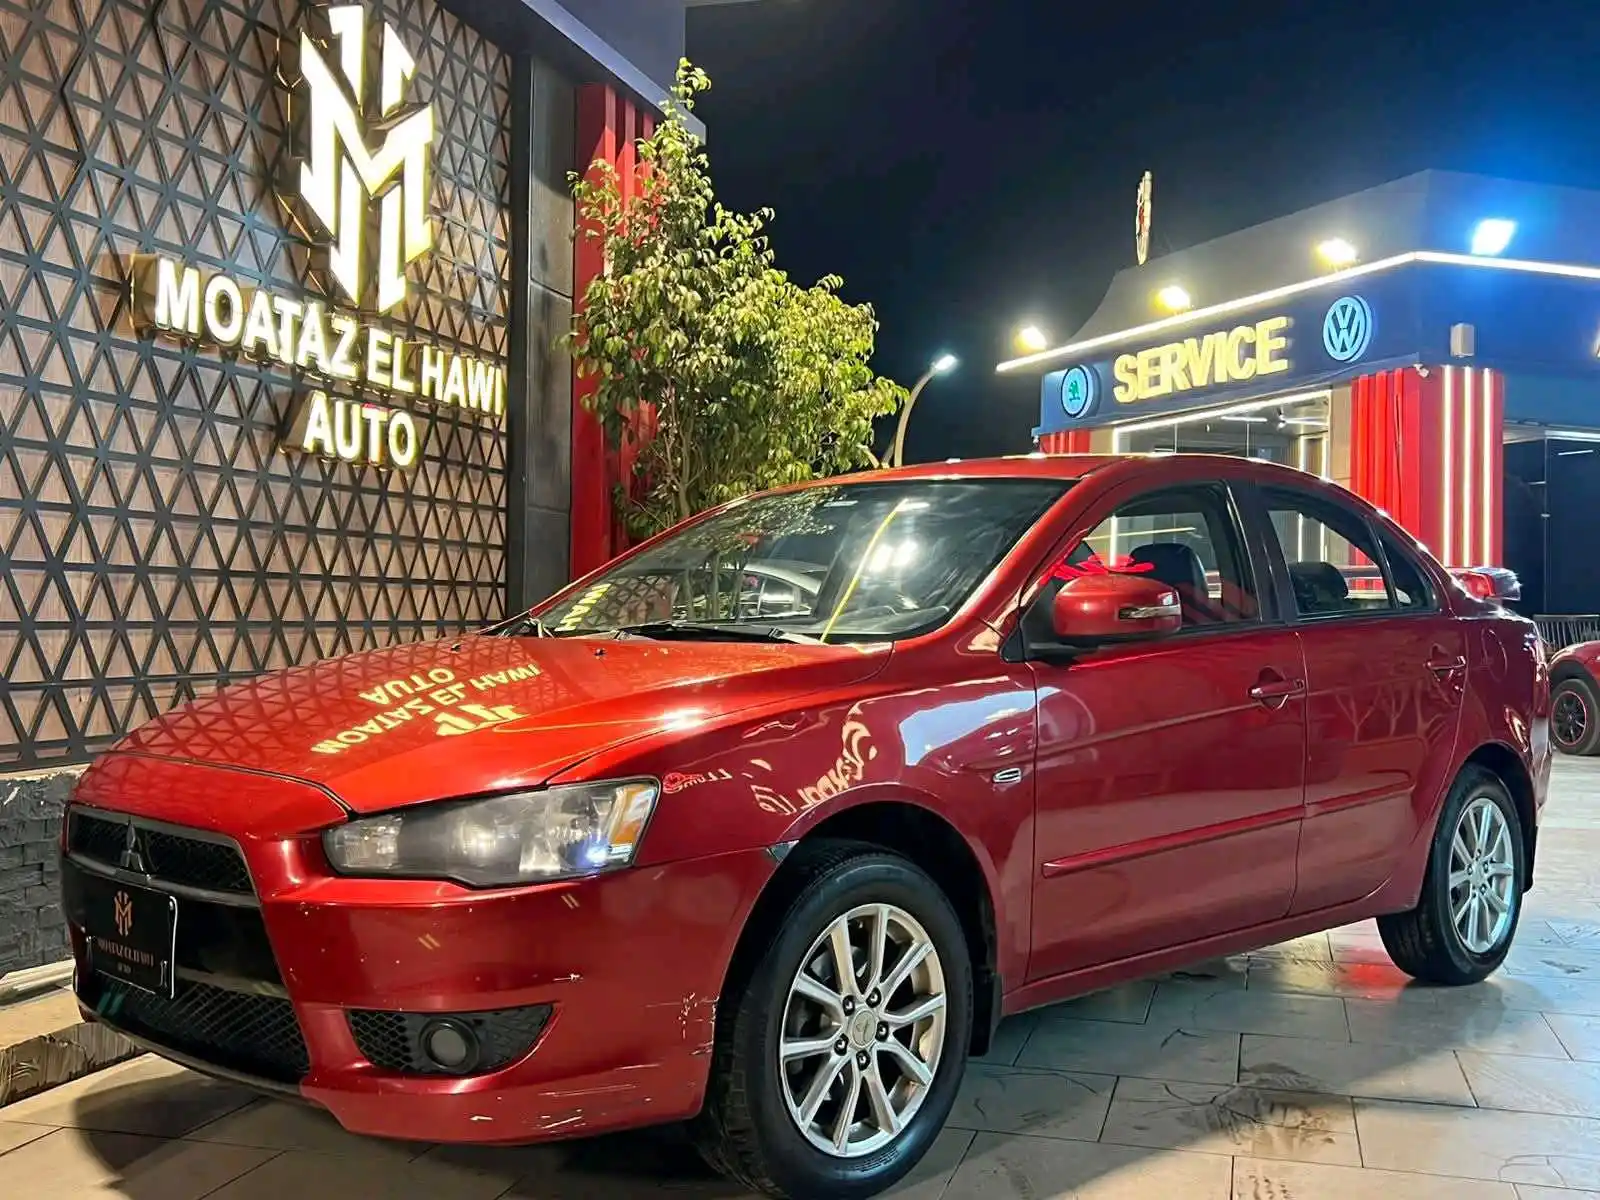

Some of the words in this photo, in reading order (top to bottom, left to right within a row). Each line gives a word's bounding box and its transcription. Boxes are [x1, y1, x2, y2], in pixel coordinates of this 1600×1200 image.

[156, 257, 359, 380] MOATAZ
[367, 327, 415, 393] EL
[421, 344, 504, 415] HAWI
[1113, 316, 1290, 403] SERVICE
[303, 390, 417, 467] AUTO
